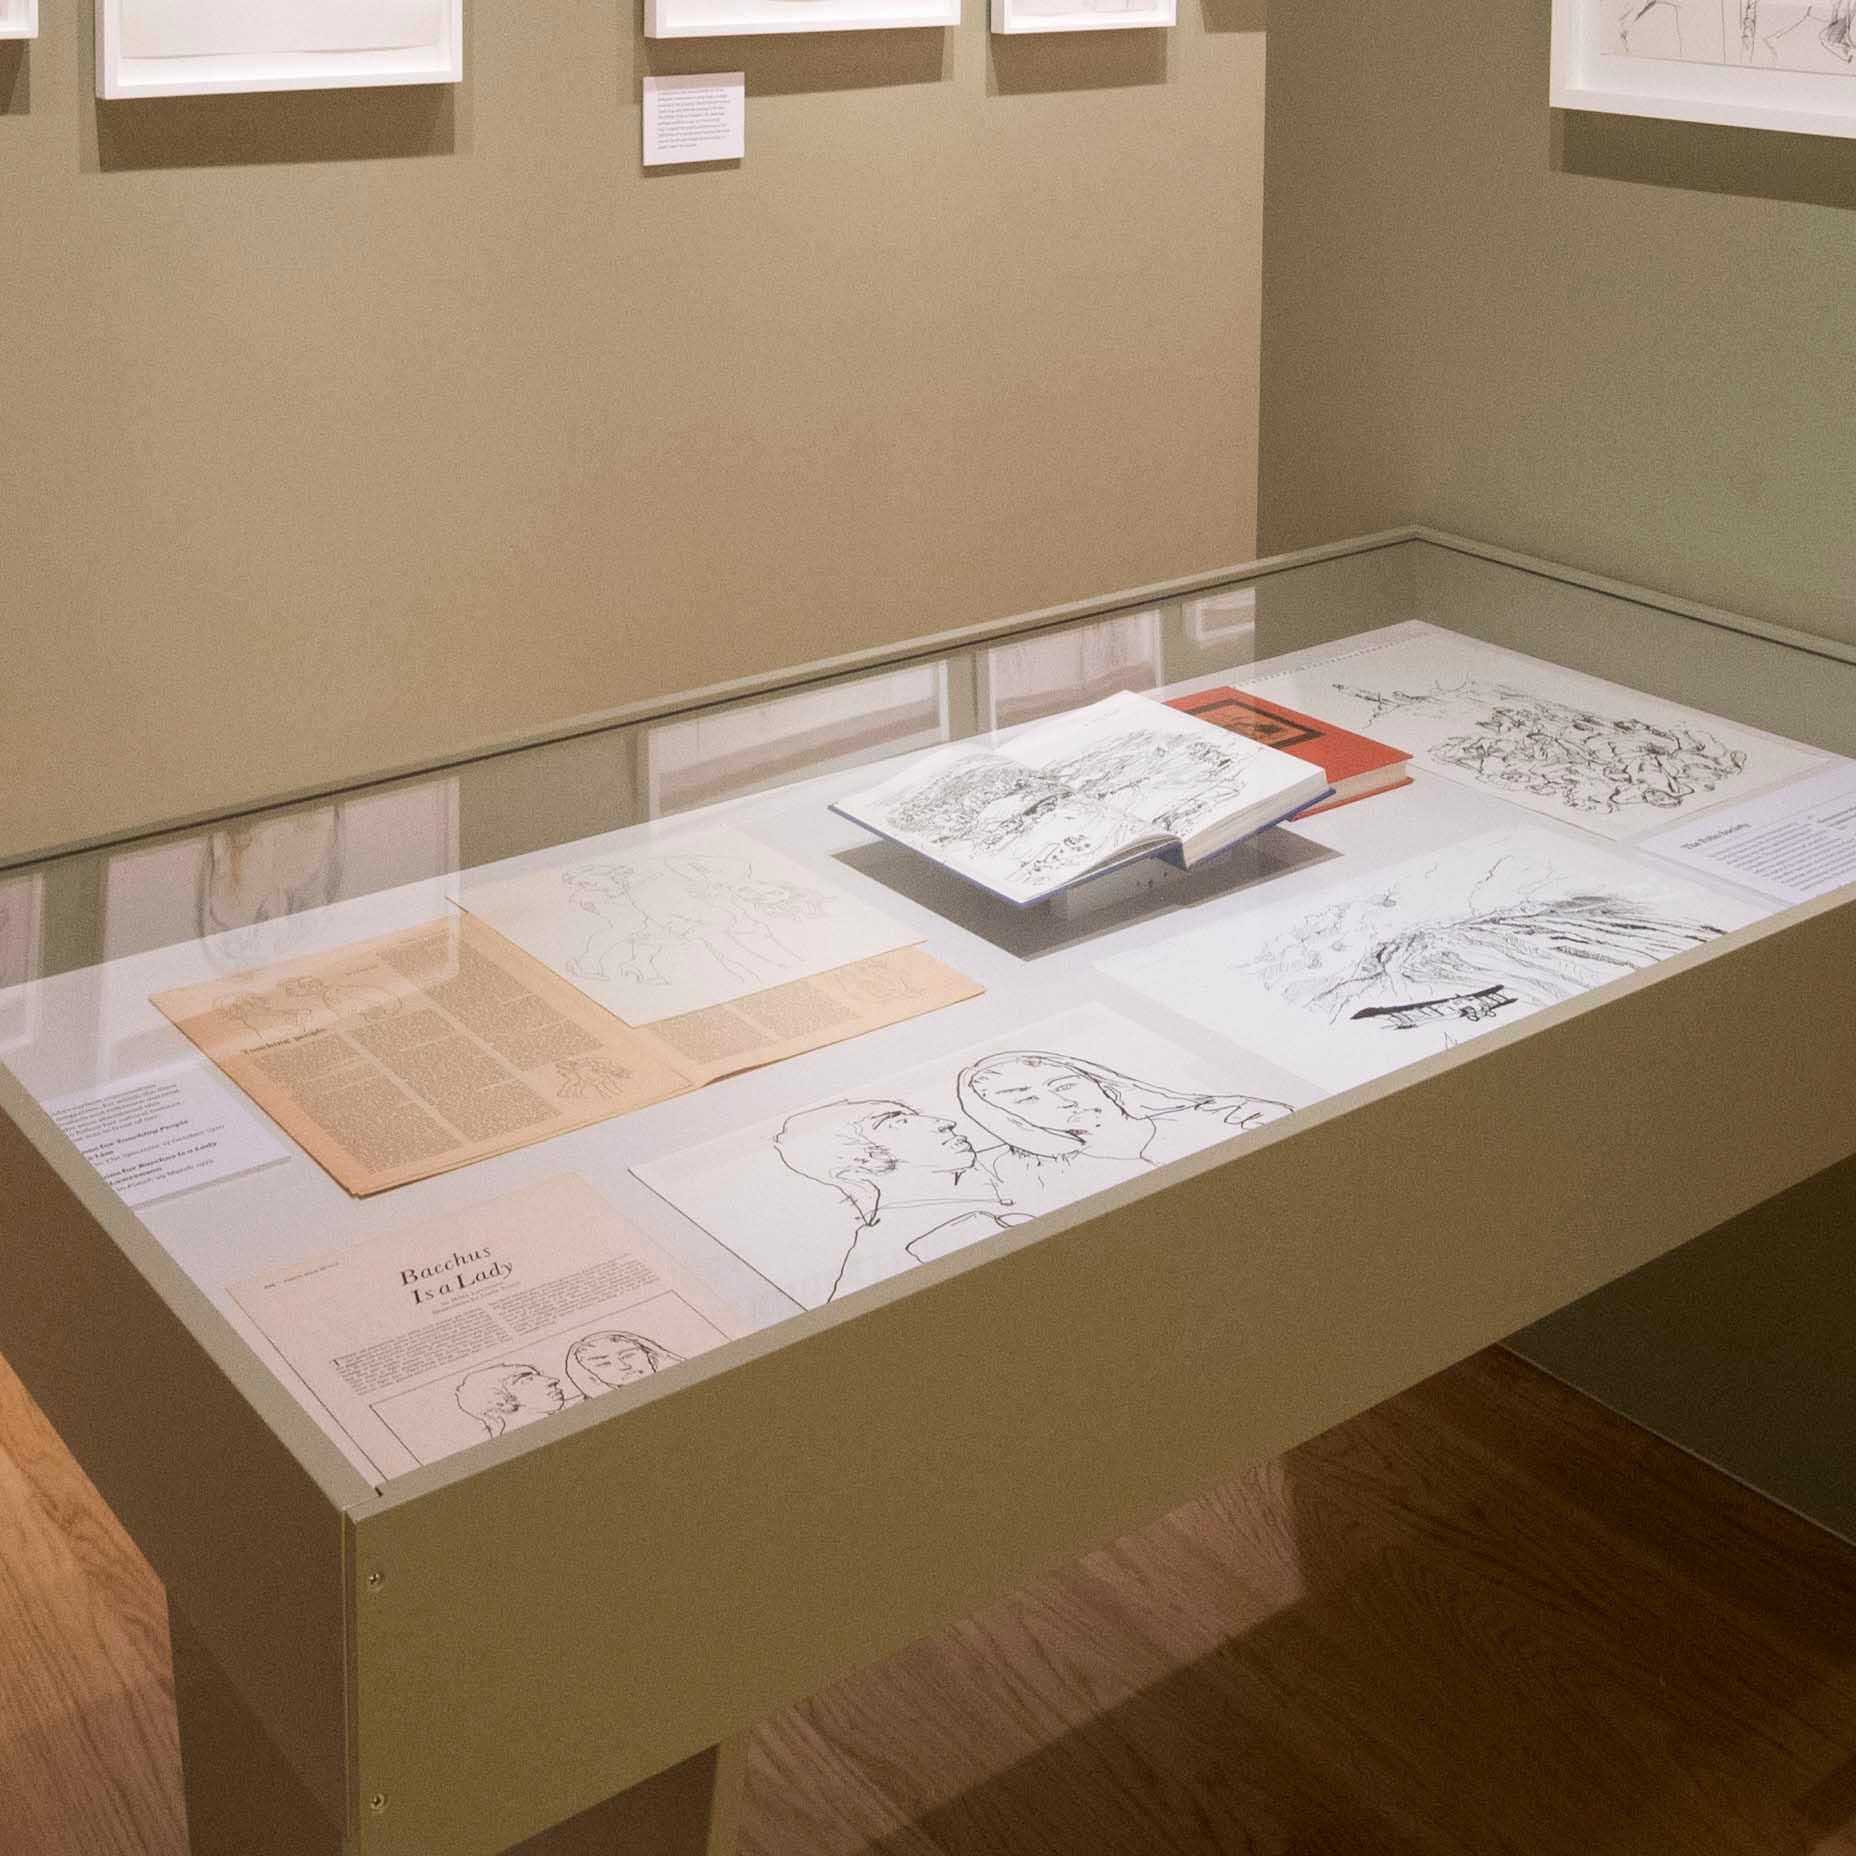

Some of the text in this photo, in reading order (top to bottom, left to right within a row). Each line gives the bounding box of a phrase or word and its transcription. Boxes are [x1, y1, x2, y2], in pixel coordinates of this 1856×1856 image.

[400, 1247, 492, 1286] Bacchus
[412, 1288, 435, 1305] Is
[439, 1284, 453, 1296] a
[456, 1261, 513, 1290] Lady
